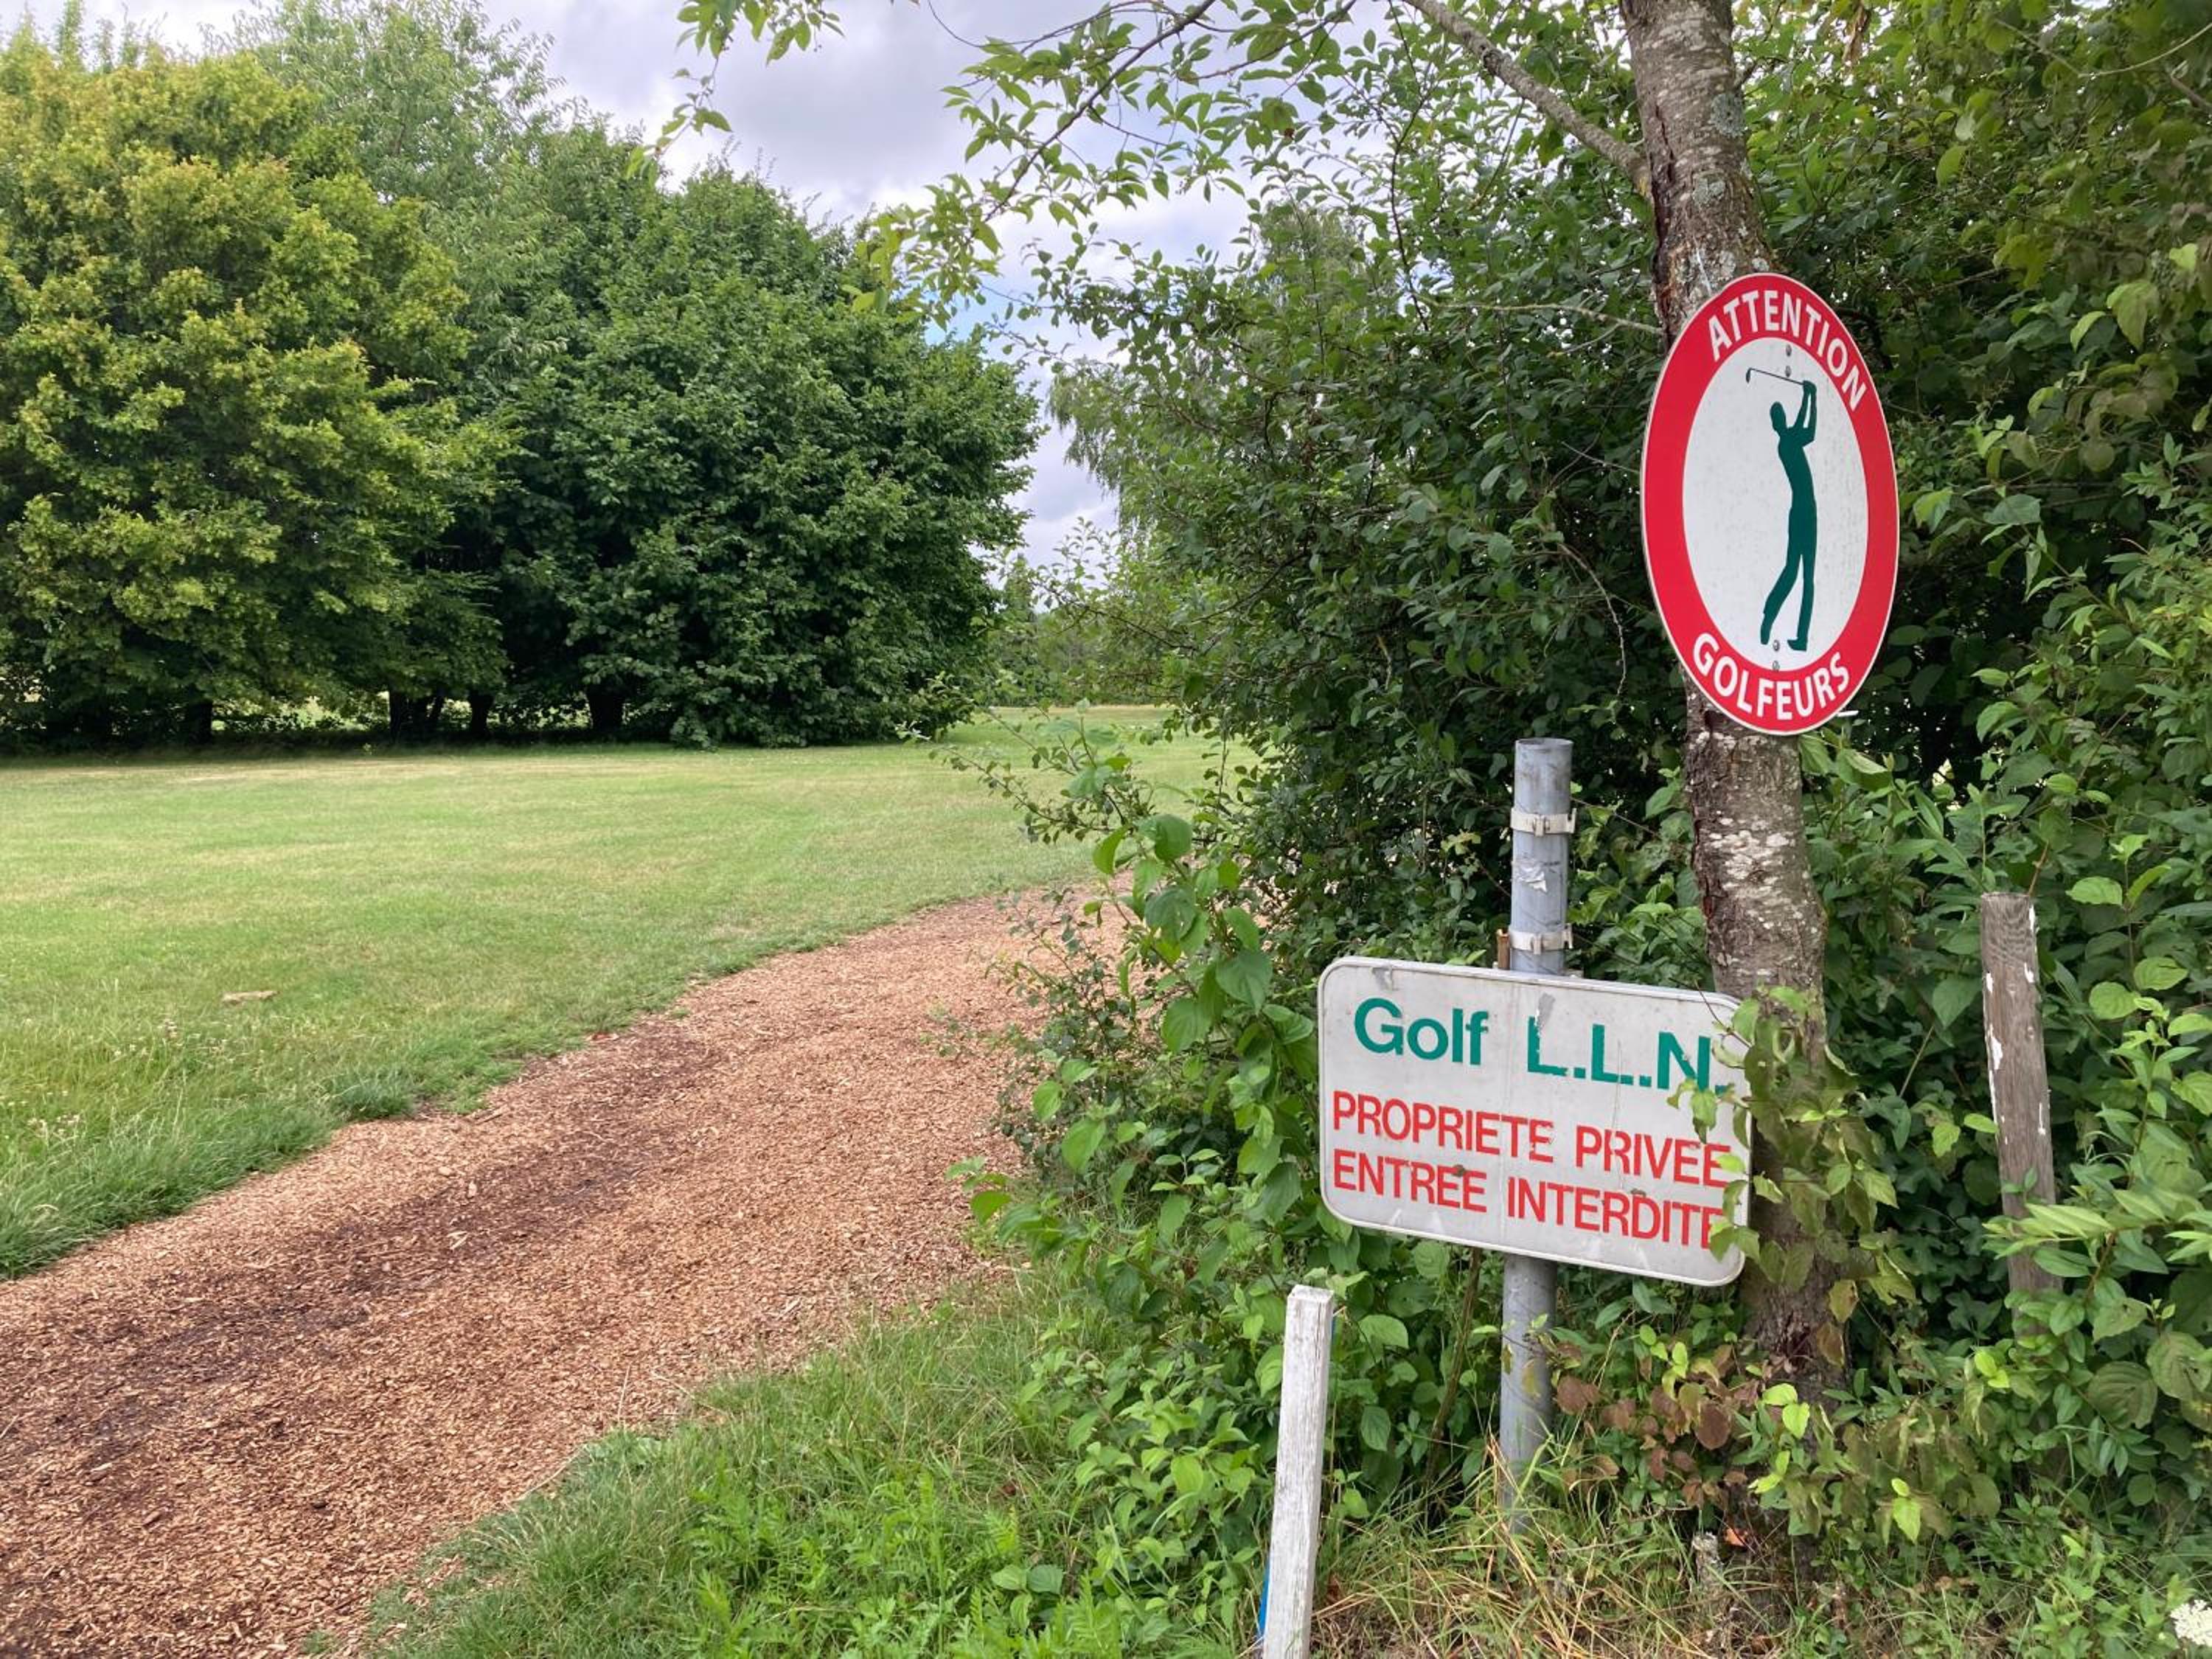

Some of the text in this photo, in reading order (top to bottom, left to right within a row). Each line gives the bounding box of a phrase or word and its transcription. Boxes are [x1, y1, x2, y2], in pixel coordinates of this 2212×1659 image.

[1708, 290, 1867, 411] ATTENTION
[1693, 632, 1849, 720] GOLFEURS
[1354, 997, 1488, 1066] Golf
[1333, 1091, 1731, 1188] PROPRIETE PRIVEE
[1333, 1148, 1486, 1213] ENTREE
